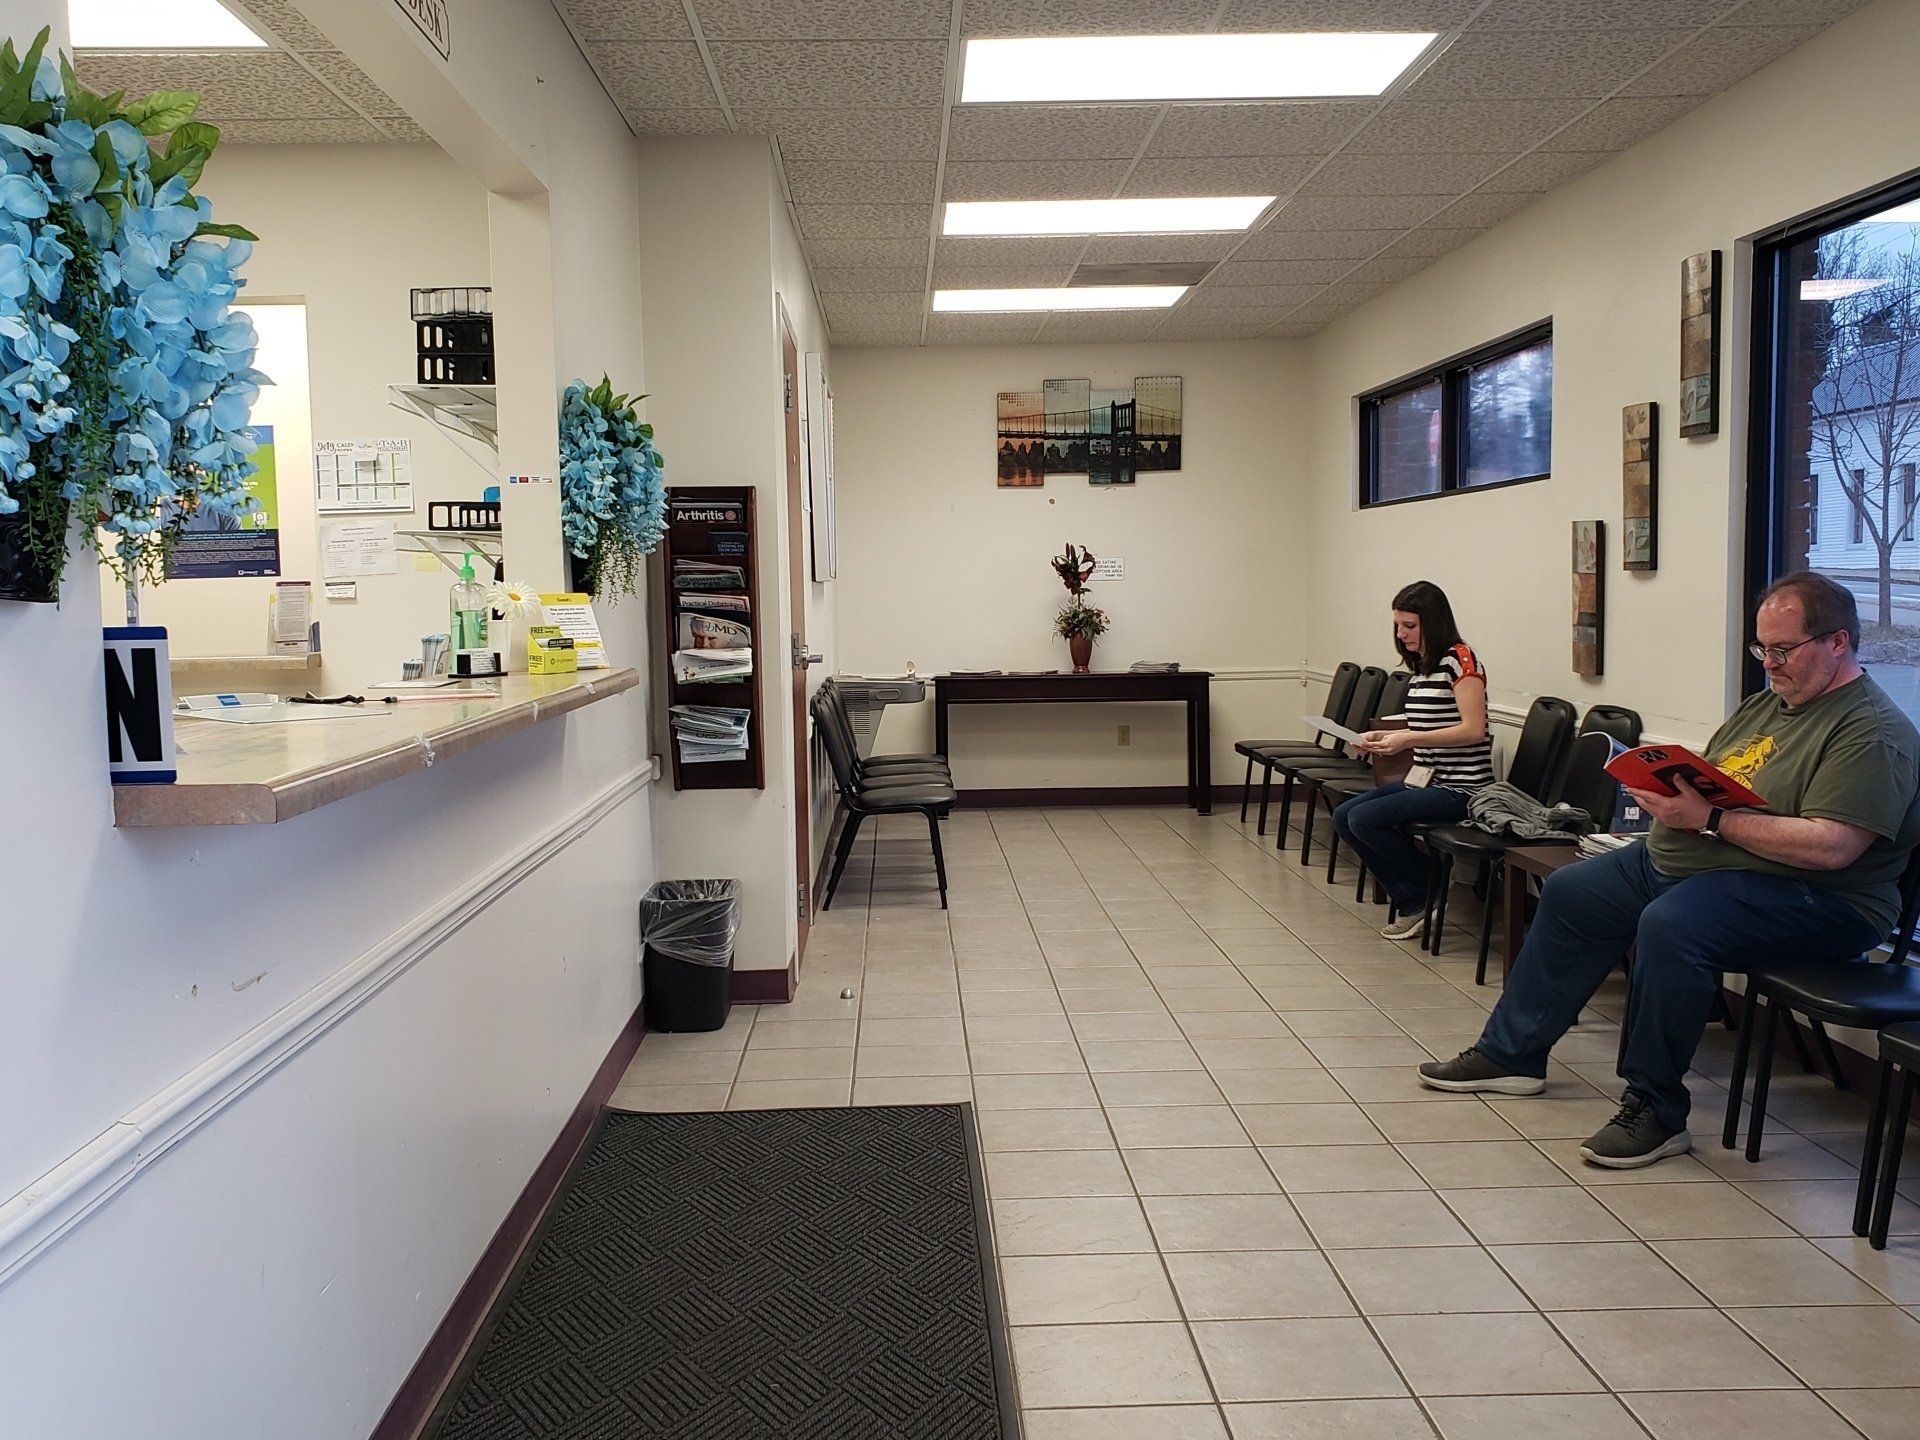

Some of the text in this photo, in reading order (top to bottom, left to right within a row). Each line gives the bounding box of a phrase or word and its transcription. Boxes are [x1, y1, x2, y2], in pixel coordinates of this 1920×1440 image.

[676, 510, 725, 521] Arthritis
[530, 626, 544, 634] FREE
[702, 621, 738, 636] ebMD
